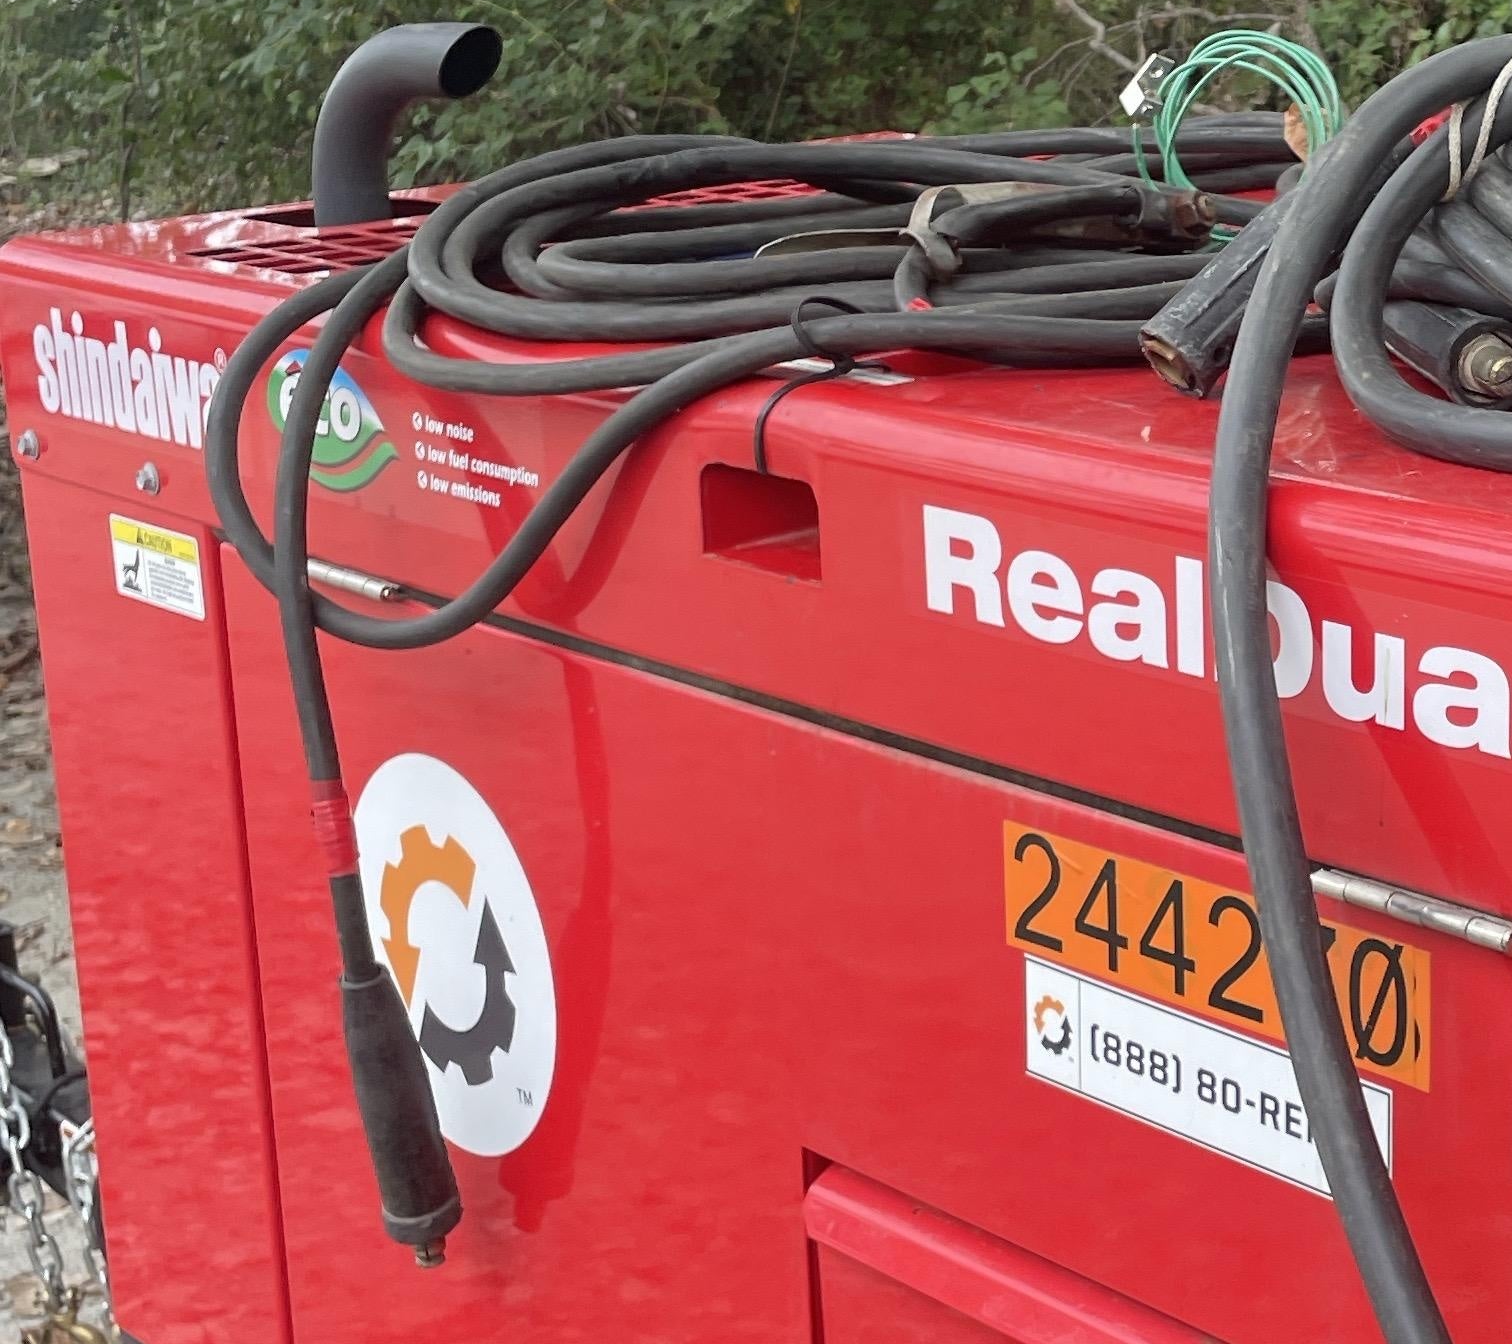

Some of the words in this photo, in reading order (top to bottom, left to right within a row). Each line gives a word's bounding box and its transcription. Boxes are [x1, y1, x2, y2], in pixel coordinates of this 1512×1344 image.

[425, 415, 445, 435] low
[445, 421, 474, 444] noise
[428, 444, 447, 465] low
[448, 449, 469, 471] fuel
[471, 457, 540, 489] consumption
[430, 474, 450, 494] low
[451, 482, 502, 508] emissions
[1090, 1023, 1182, 1094] (888)
